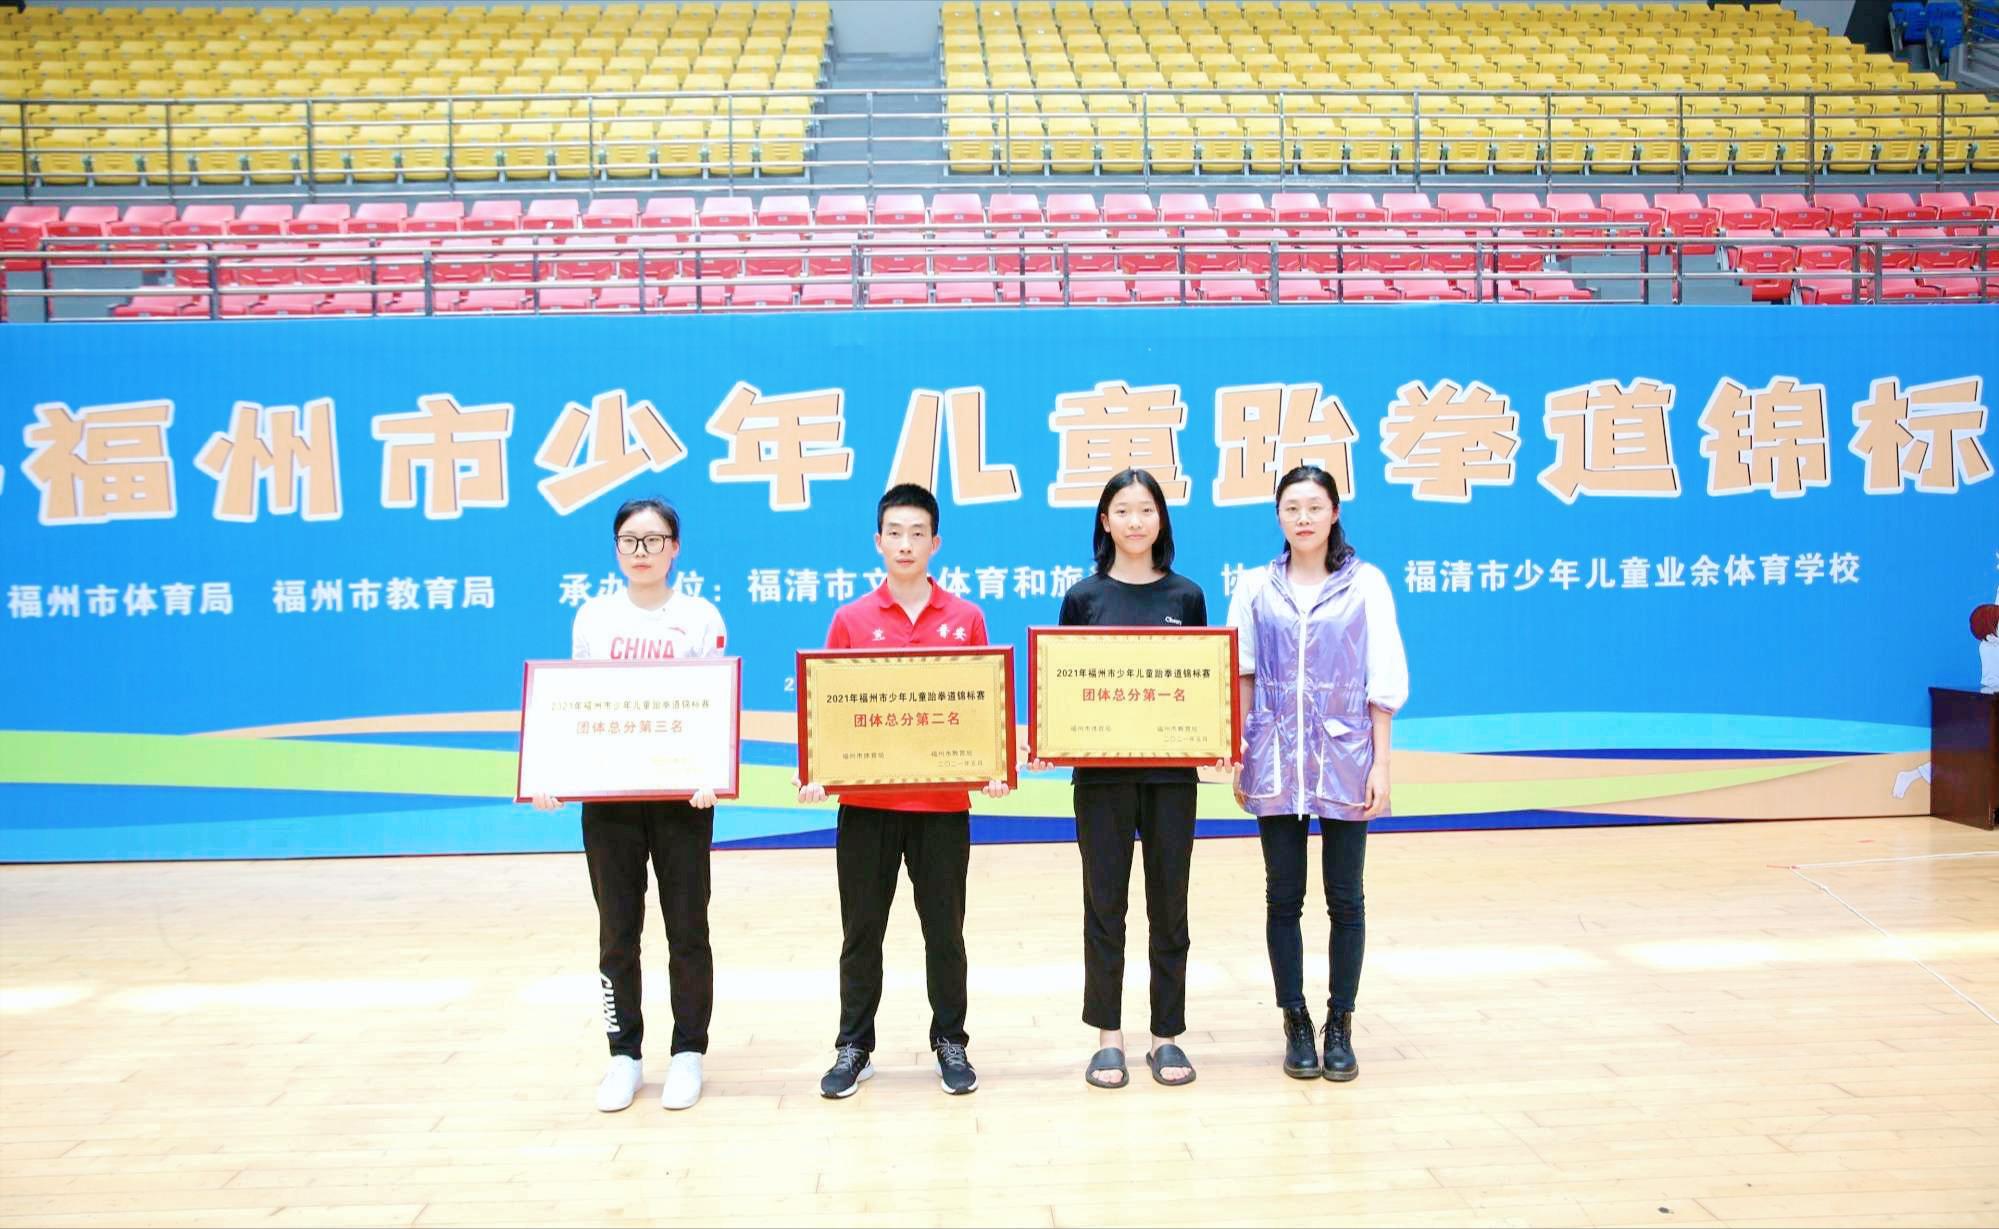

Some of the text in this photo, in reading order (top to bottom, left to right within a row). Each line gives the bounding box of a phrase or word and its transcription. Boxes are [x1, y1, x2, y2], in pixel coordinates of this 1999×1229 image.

[1404, 552, 1860, 593] 福清市少年儿童业余体育学校
[7, 582, 234, 618] 福州市体育局
[272, 576, 495, 613] 福州市教育局
[610, 637, 675, 660] CHINA
[826, 691, 985, 704] 2021年福州市少年儿童跆拳道锦标赛
[1082, 688, 1186, 702] 团体总分第一名
[576, 720, 683, 734] 团体总分第三名
[854, 712, 960, 728] 团体总分第二名
